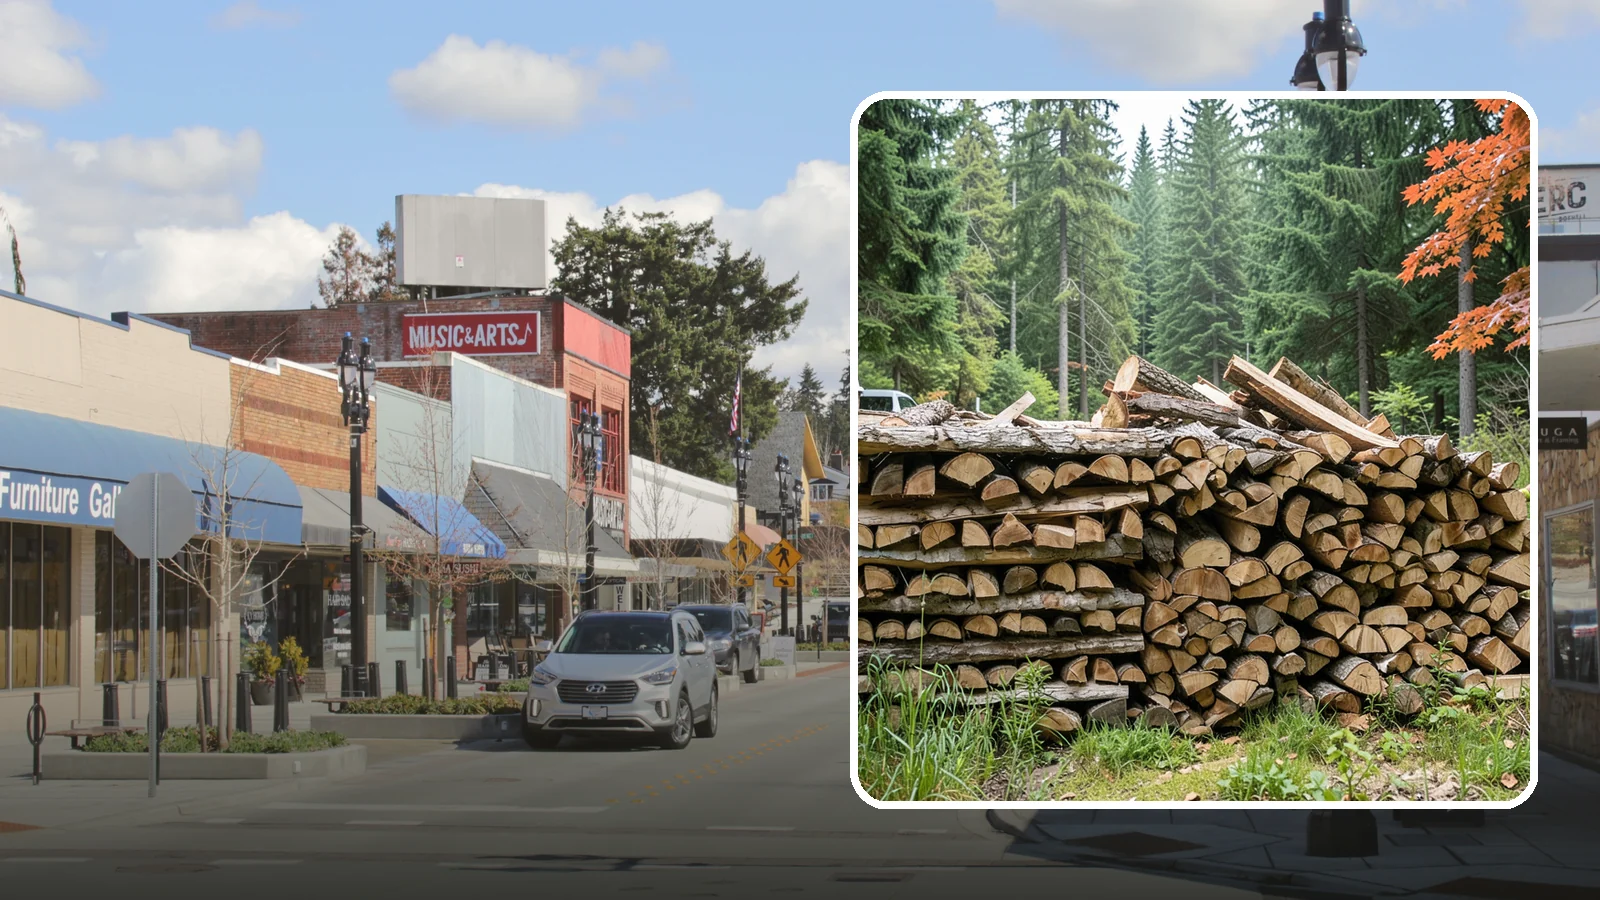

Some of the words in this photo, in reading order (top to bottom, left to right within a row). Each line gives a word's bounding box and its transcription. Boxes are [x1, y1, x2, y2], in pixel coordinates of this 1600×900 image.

[409, 323, 519, 349] MUSIC&ARTS
[1541, 428, 1577, 436] UGA
[0, 471, 79, 515] Furniture
[89, 482, 121, 519] Gal
[453, 563, 479, 574] SUSHI
